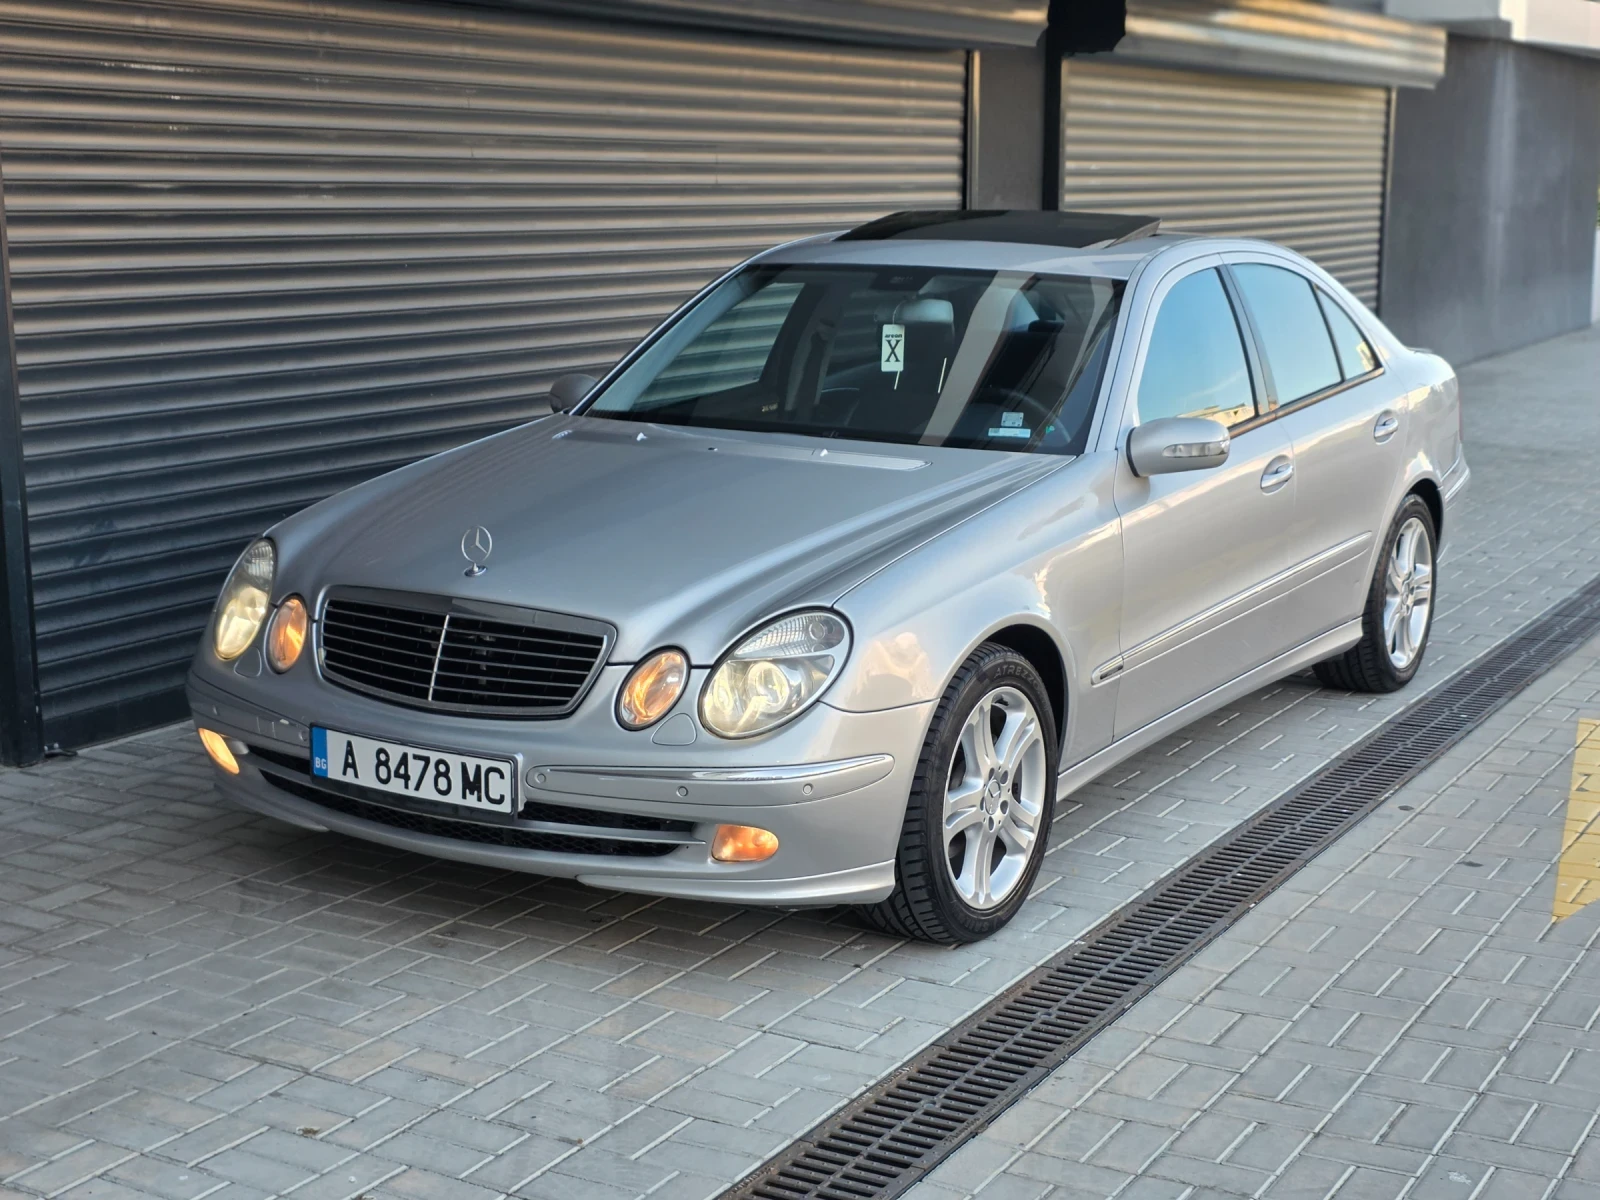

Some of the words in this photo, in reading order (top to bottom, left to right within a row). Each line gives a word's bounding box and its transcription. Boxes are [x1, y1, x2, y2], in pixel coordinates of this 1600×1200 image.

[884, 339, 902, 362] X
[315, 756, 327, 769] BG
[342, 740, 359, 779] A
[375, 747, 452, 796] 8478
[461, 761, 505, 805] MC
